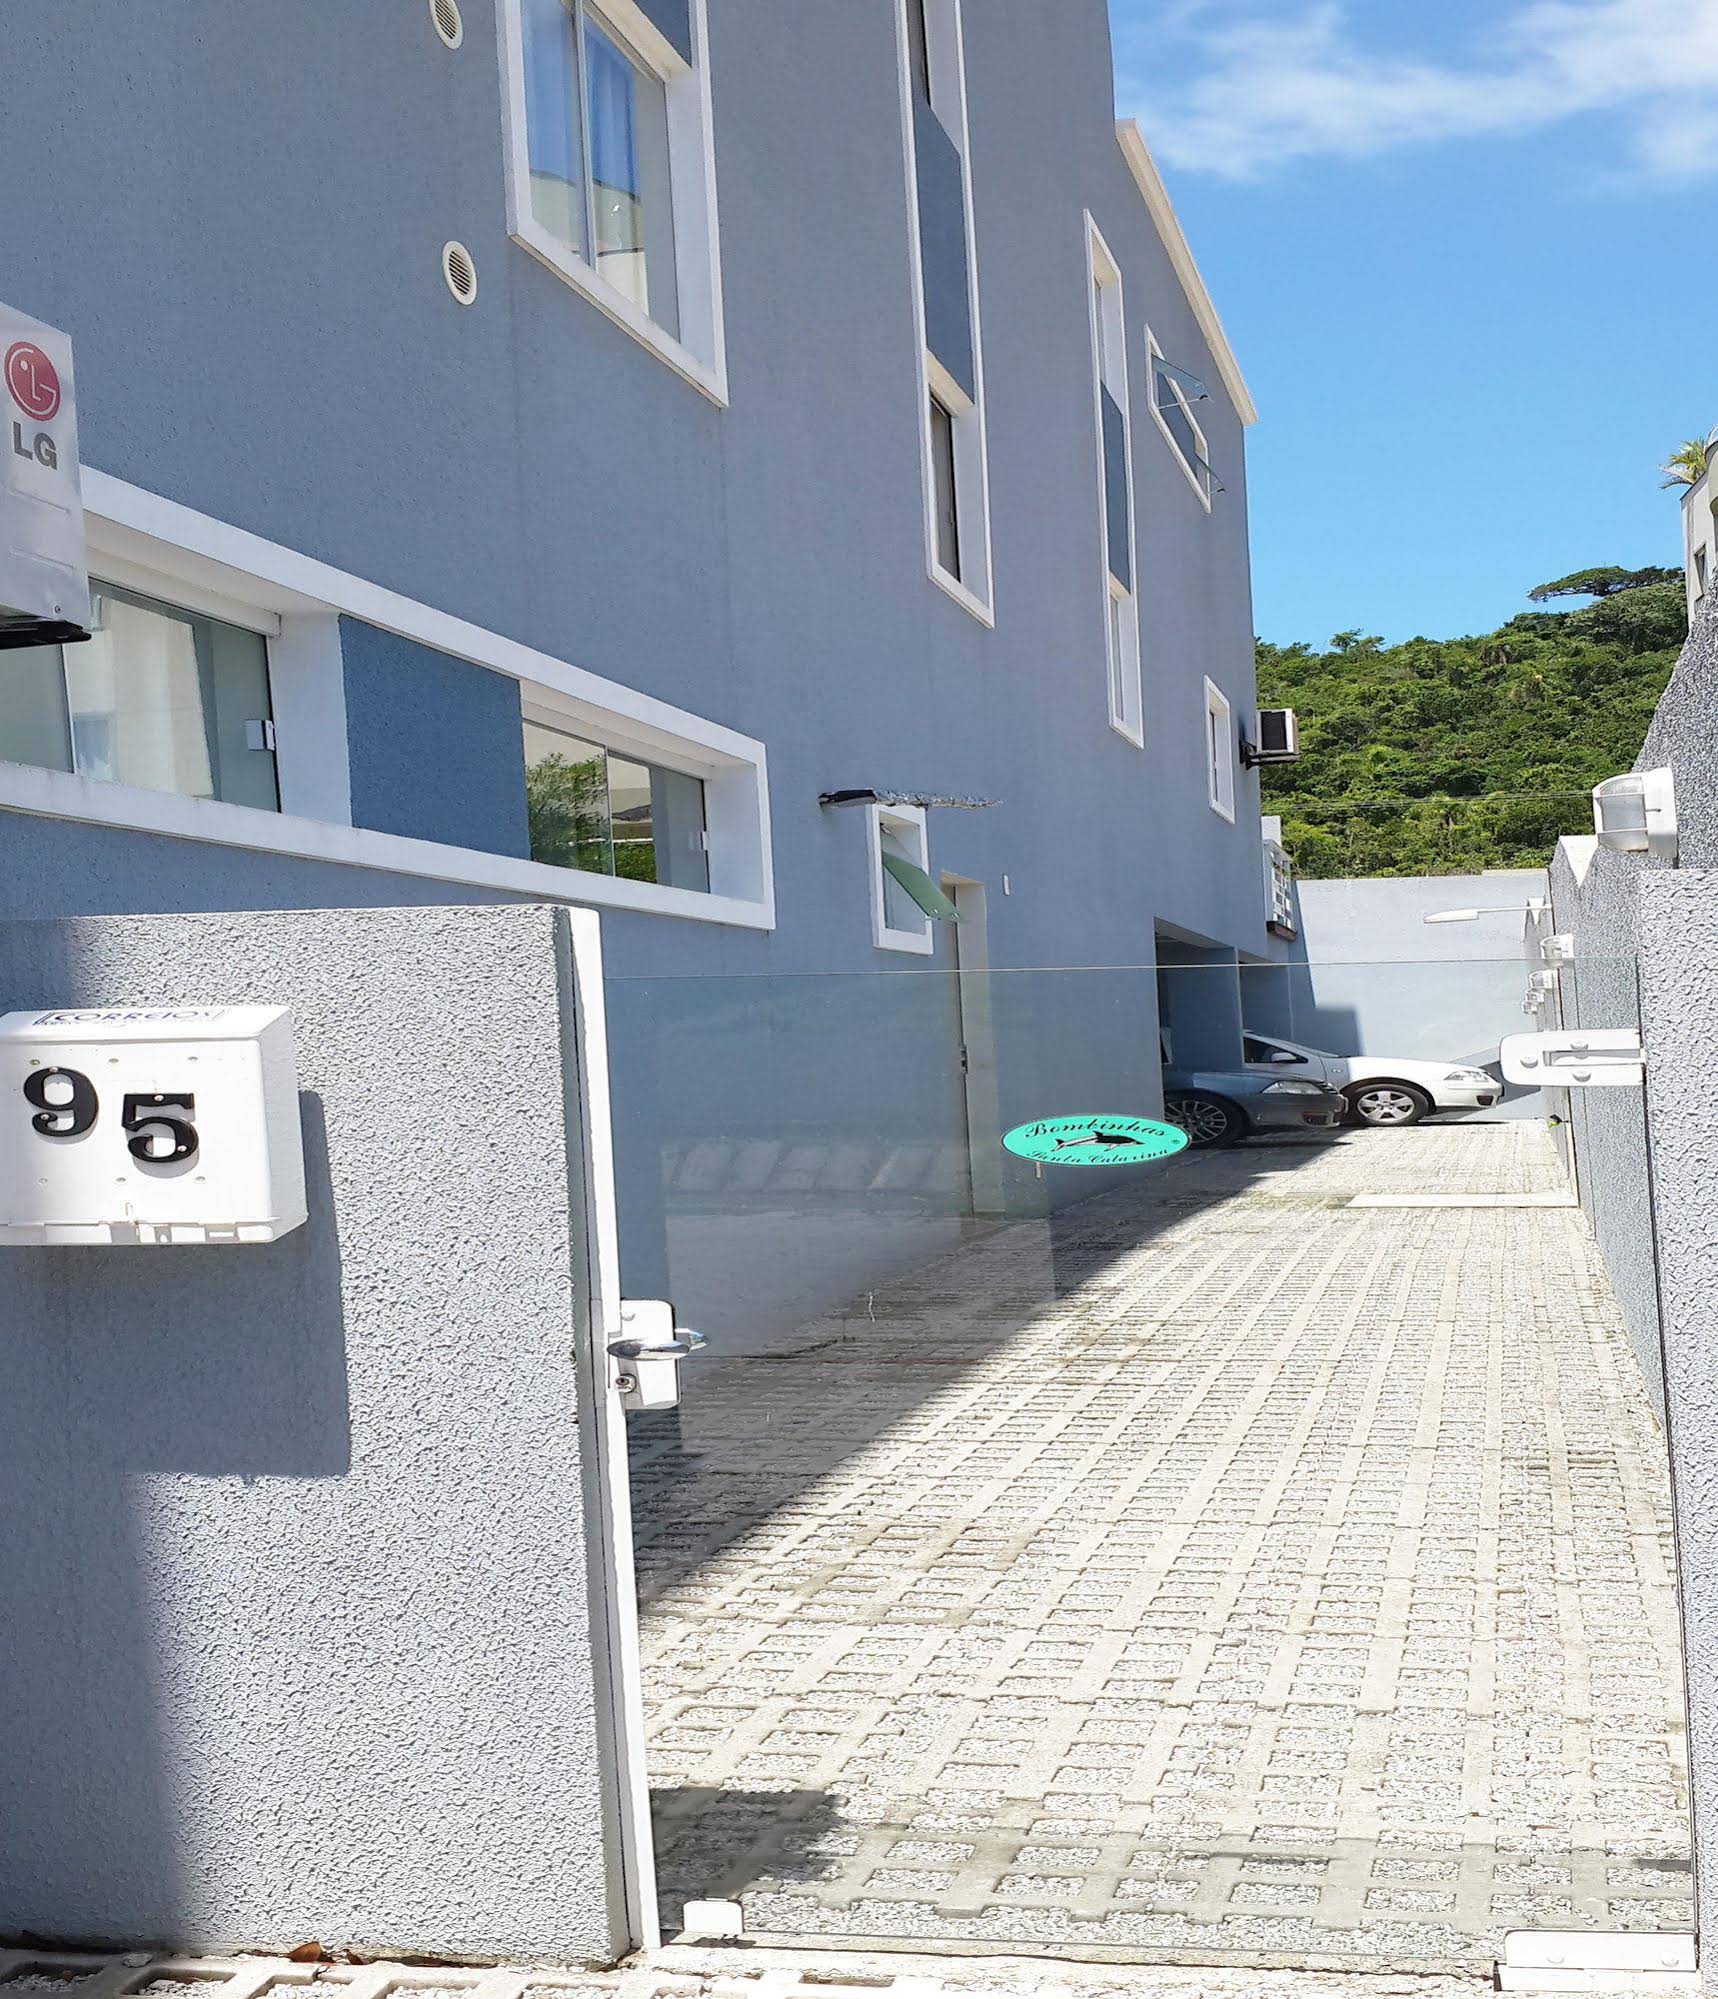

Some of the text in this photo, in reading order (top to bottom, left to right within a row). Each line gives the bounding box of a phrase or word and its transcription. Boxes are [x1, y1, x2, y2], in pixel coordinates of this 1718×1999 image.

[13, 421, 57, 471] LG
[23, 1066, 200, 1166] 95
[1024, 1119, 1165, 1137] Bombinhas
[1026, 1149, 1168, 1163] Santa Catarina
